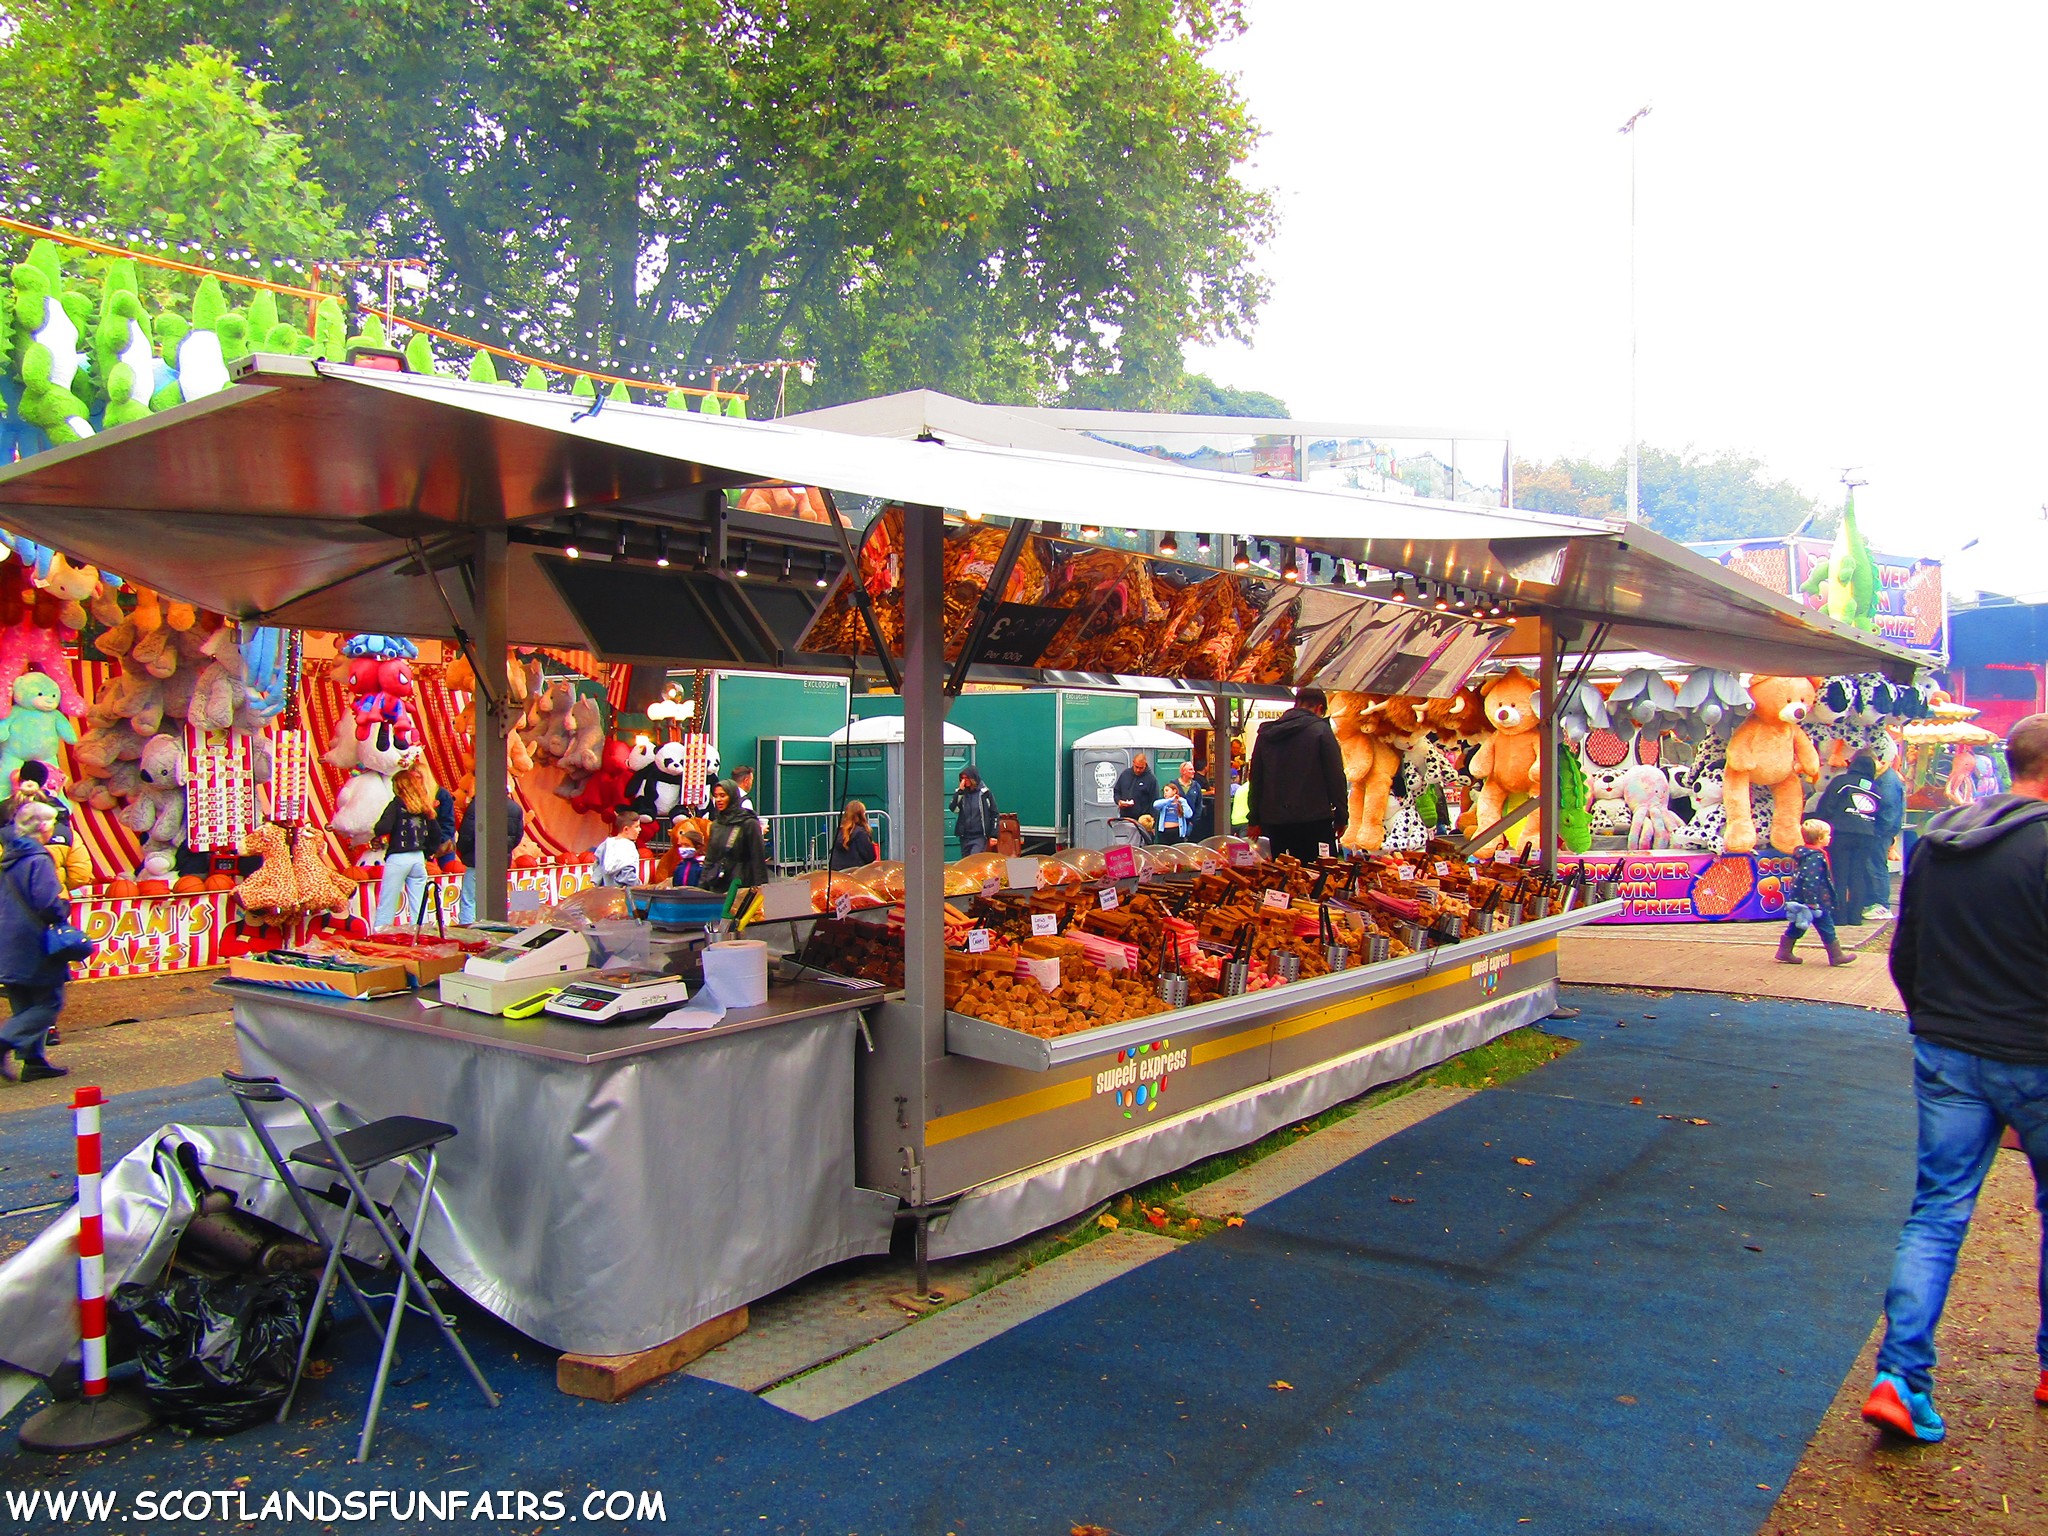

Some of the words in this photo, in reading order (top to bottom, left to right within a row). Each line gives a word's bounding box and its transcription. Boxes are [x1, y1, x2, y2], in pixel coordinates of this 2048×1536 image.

[1873, 614, 1916, 638] PRIZE
[200, 760, 214, 769] TO
[219, 770, 253, 780] PRIZE
[1628, 861, 1690, 880] OVER
[1758, 857, 1796, 876] SCO
[1616, 881, 1657, 898] WIN
[1757, 876, 1786, 913] 8
[1633, 898, 1691, 916] PRIZE
[86, 903, 215, 943] DAN'S
[1096, 1058, 1137, 1095] sweet
[1139, 1048, 1188, 1080] express
